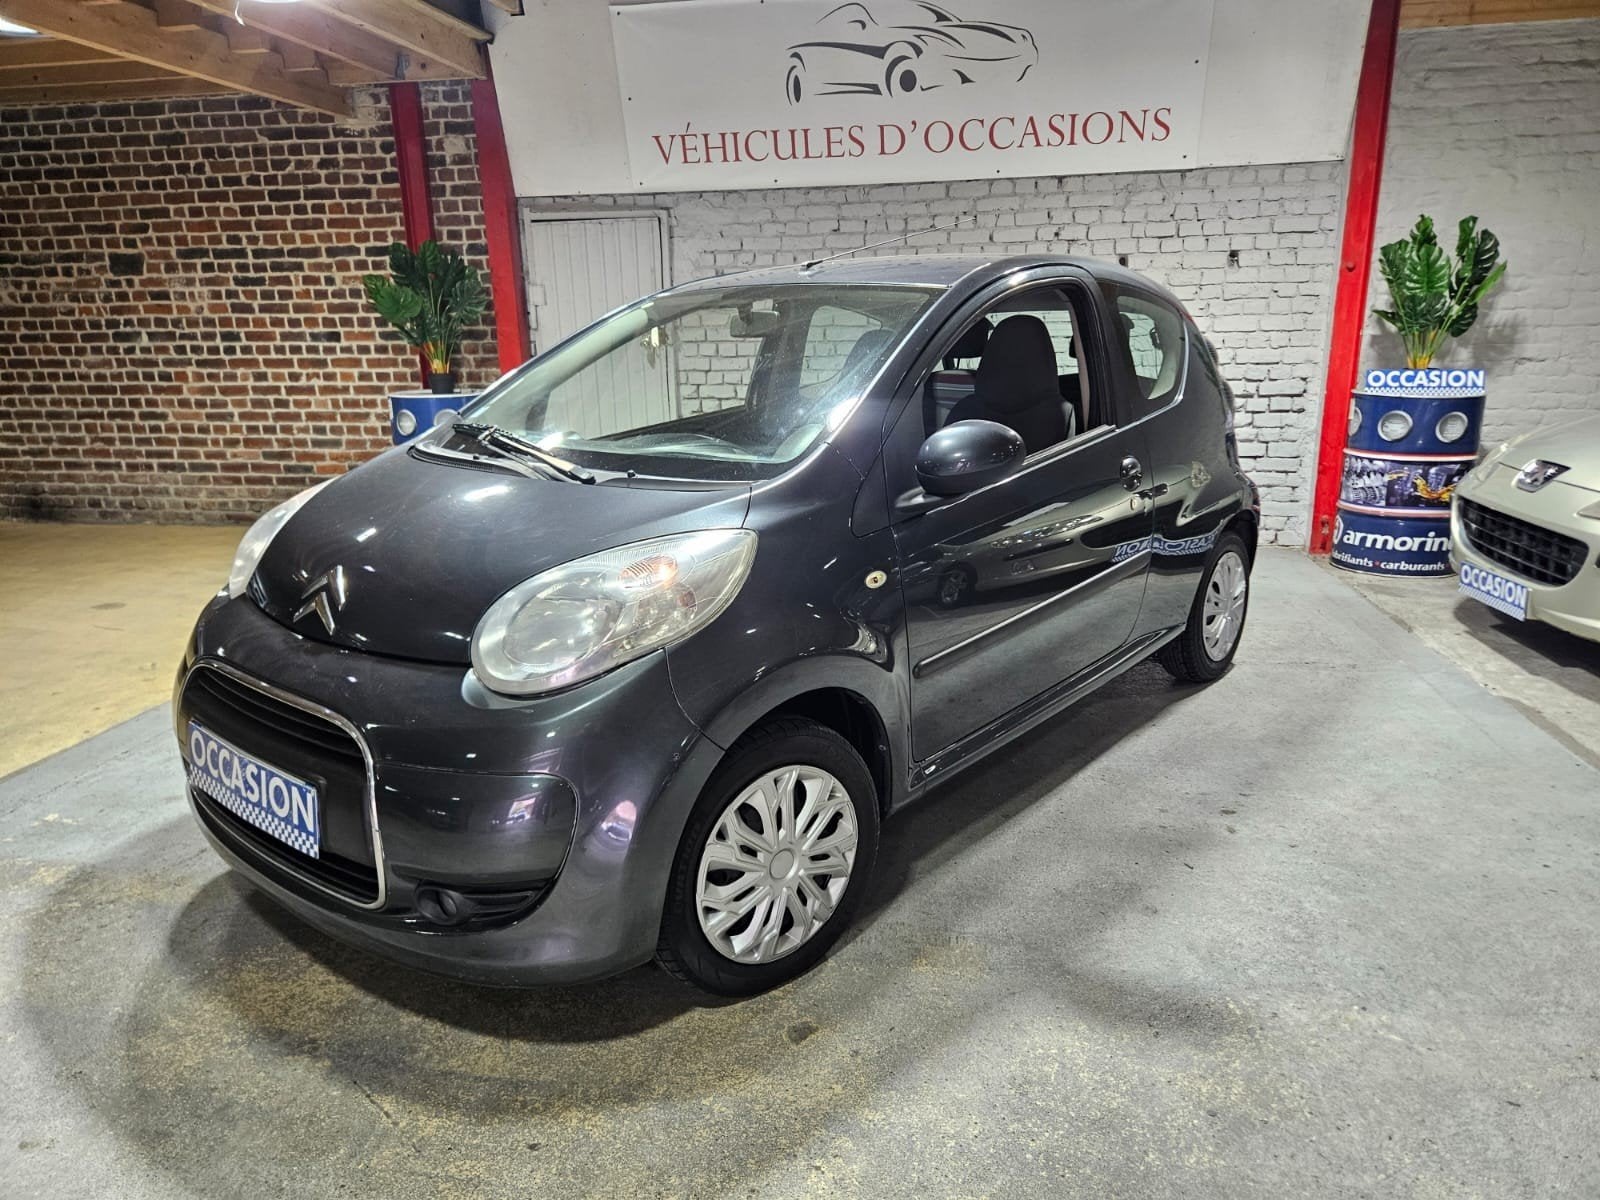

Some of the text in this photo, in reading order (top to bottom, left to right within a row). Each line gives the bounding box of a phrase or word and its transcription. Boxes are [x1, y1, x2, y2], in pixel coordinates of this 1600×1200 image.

[652, 107, 1174, 166] VÉHICULES D'OCCASIONS
[1367, 370, 1485, 387] OCCASION
[1380, 560, 1445, 571] carburants
[1461, 564, 1527, 610] OCCASION
[190, 729, 315, 833] OCCASION
